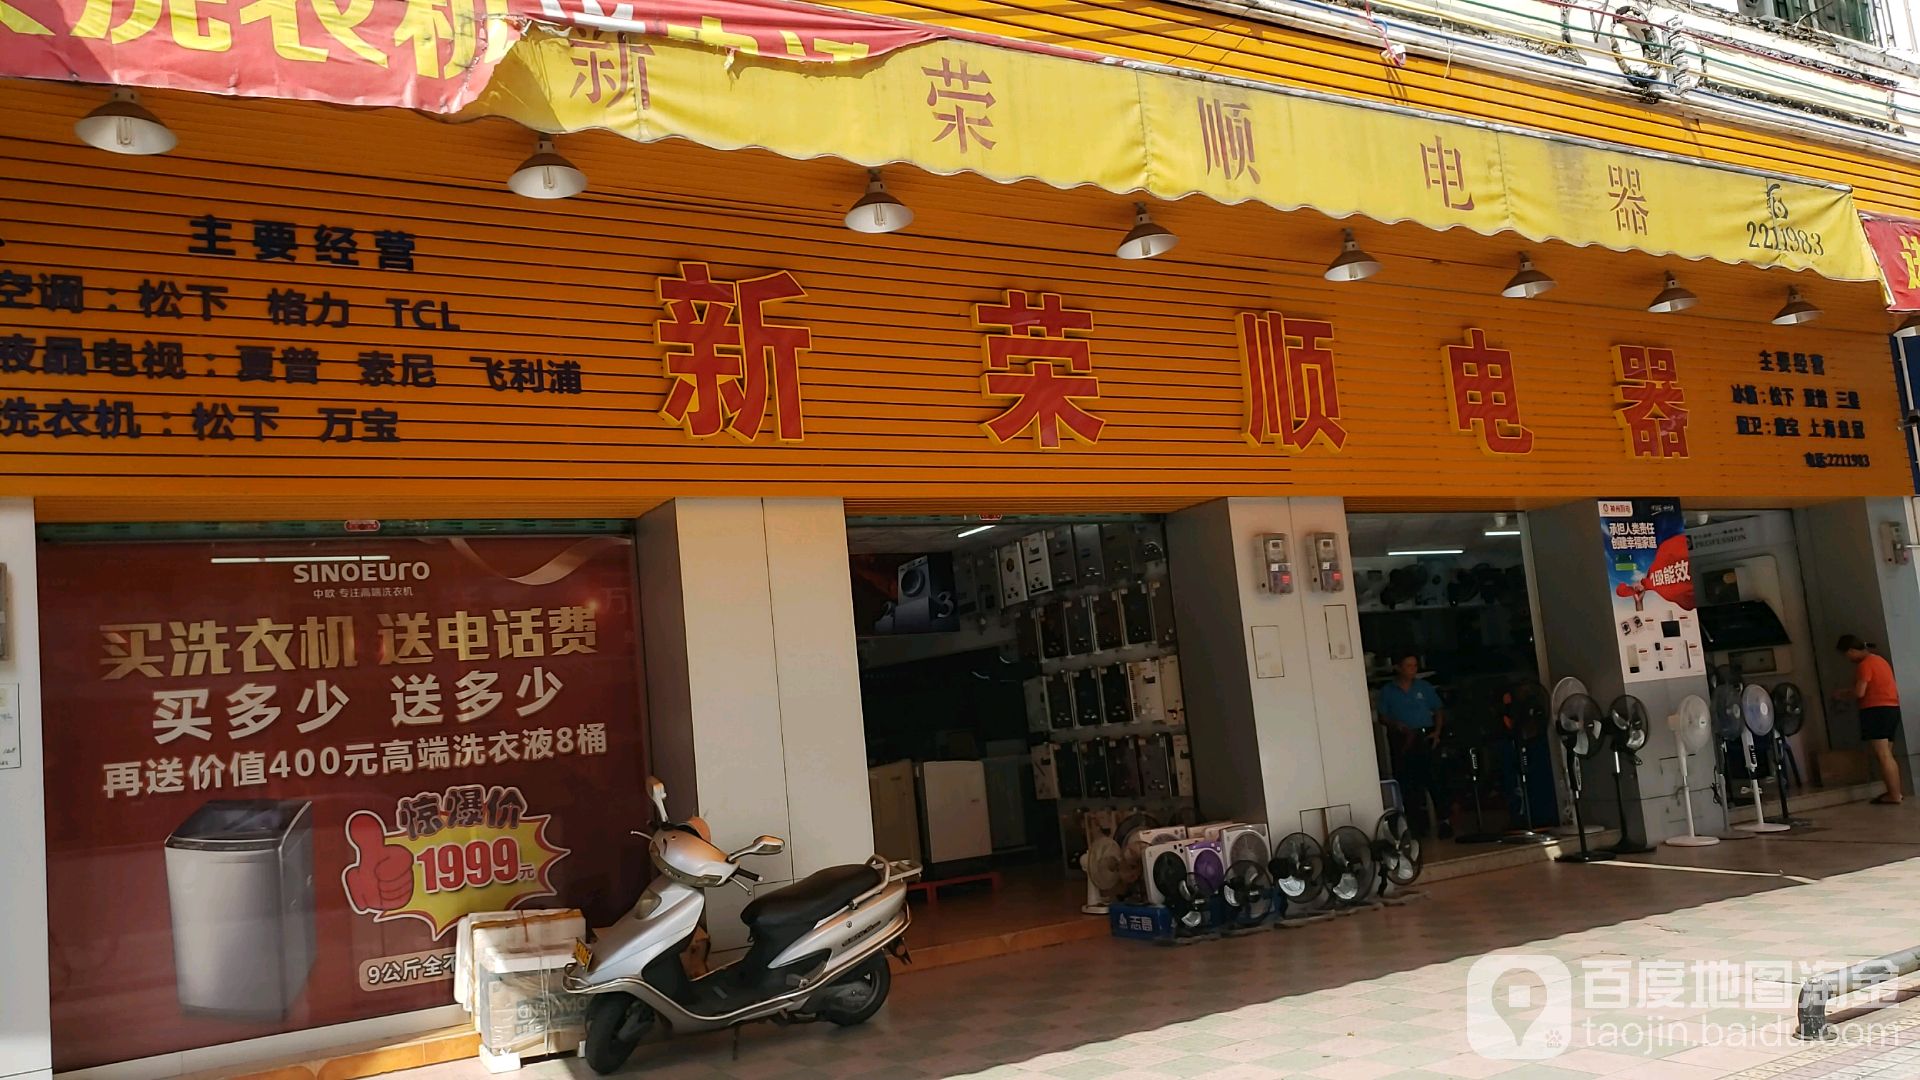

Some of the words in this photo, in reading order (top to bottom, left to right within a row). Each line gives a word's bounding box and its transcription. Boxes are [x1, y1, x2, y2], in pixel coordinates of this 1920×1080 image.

[569, 30, 1649, 236] 新荣顺电器
[188, 215, 416, 272] 主要经营
[1747, 221, 1824, 256] 2211983
[267, 289, 350, 329] 格力
[387, 299, 460, 332] TCL
[357, 350, 437, 388] 索尼
[470, 354, 583, 395] 飞利浦
[654, 261, 1690, 459] 新荣顺电器
[317, 407, 399, 443] 万宝
[1609, 522, 1655, 535] 承担人类责任
[313, 589, 335, 599] 中欧
[339, 586, 414, 598] 专注高端洗衣机
[100, 616, 358, 680] 买洗衣机
[378, 606, 598, 664] 送电话费
[153, 680, 349, 744] 买多少
[391, 667, 563, 727] 送多少
[103, 723, 607, 798] 再送价值400元高端洗衣液8桶
[399, 786, 526, 839] 惊爆价
